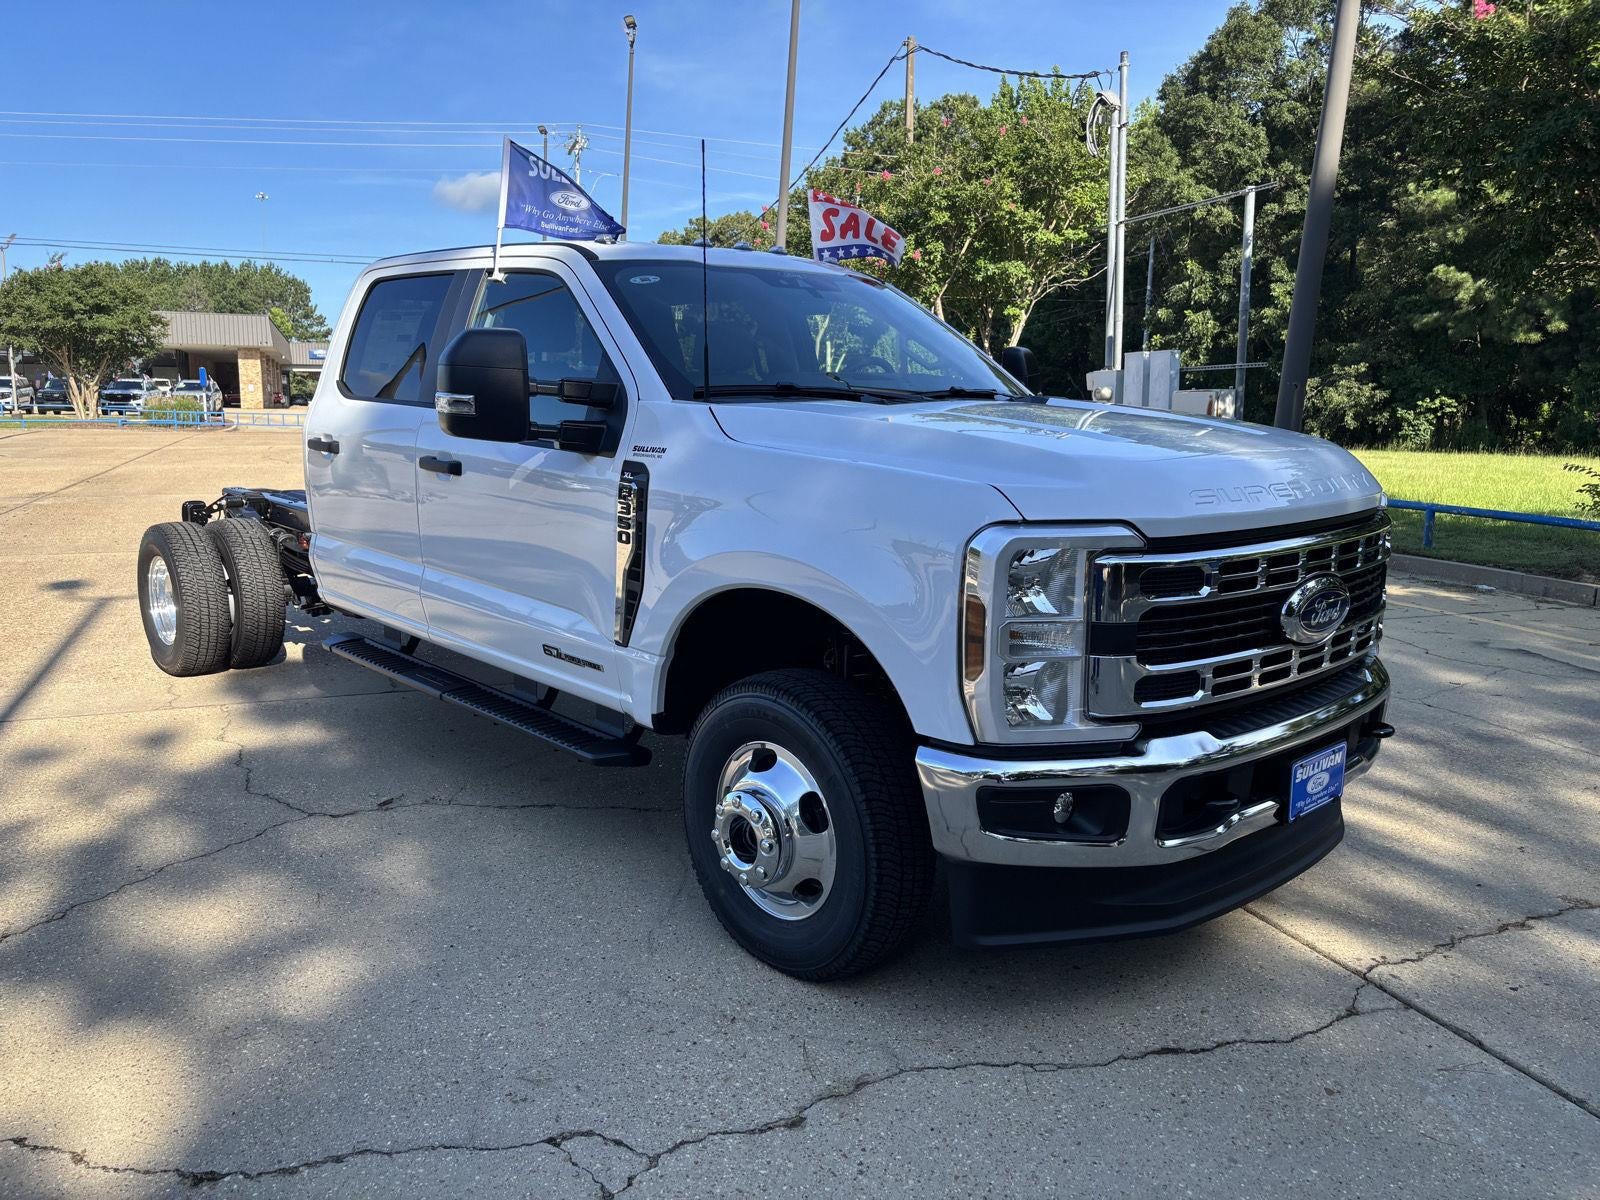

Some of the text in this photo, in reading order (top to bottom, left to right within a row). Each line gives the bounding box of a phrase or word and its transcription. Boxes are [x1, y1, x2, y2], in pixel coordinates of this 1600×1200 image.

[557, 193, 582, 208] Ford
[543, 209, 555, 219] Go
[555, 213, 592, 226] Anywhere
[820, 207, 900, 254] SALE
[632, 444, 667, 454] SULLIVAN
[623, 471, 634, 479] XL
[1189, 480, 1315, 505] SUPER
[1310, 597, 1342, 626] Ford
[1295, 750, 1343, 784] SULLIVAN
